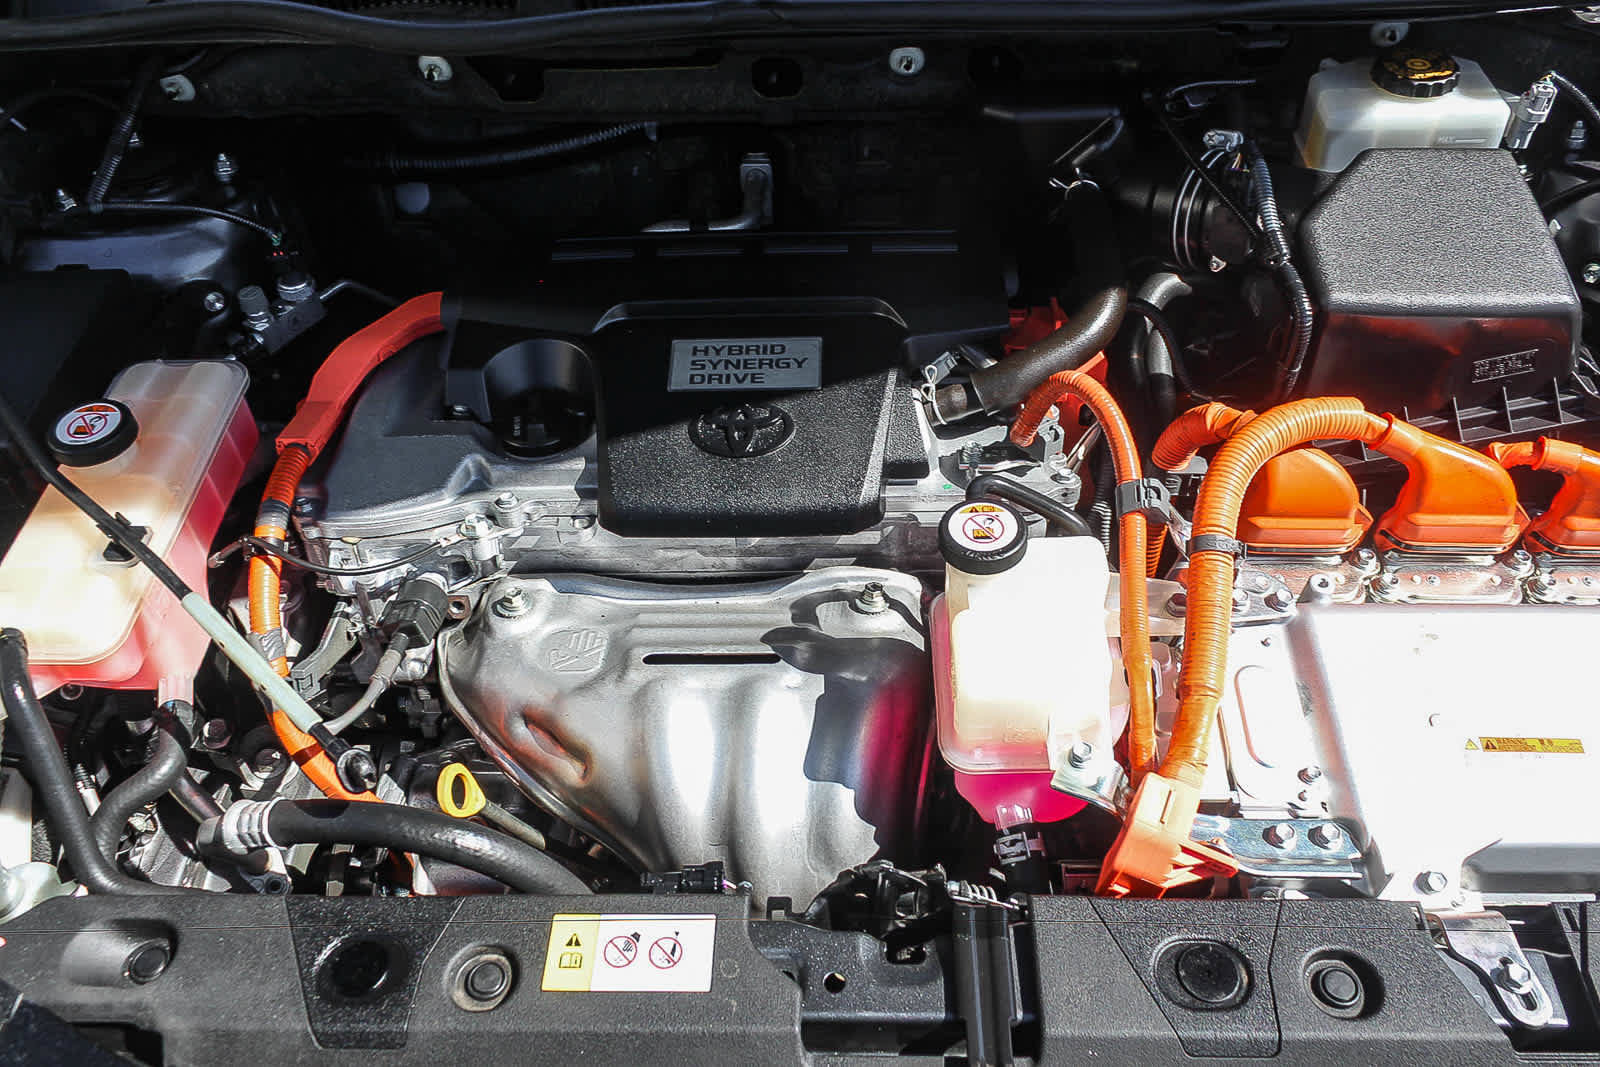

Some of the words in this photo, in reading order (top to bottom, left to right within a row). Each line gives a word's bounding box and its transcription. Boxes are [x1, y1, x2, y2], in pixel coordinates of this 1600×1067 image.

[691, 344, 786, 357] HYBRID
[689, 357, 809, 371] SYNERGY
[688, 373, 765, 385] DRIVE
